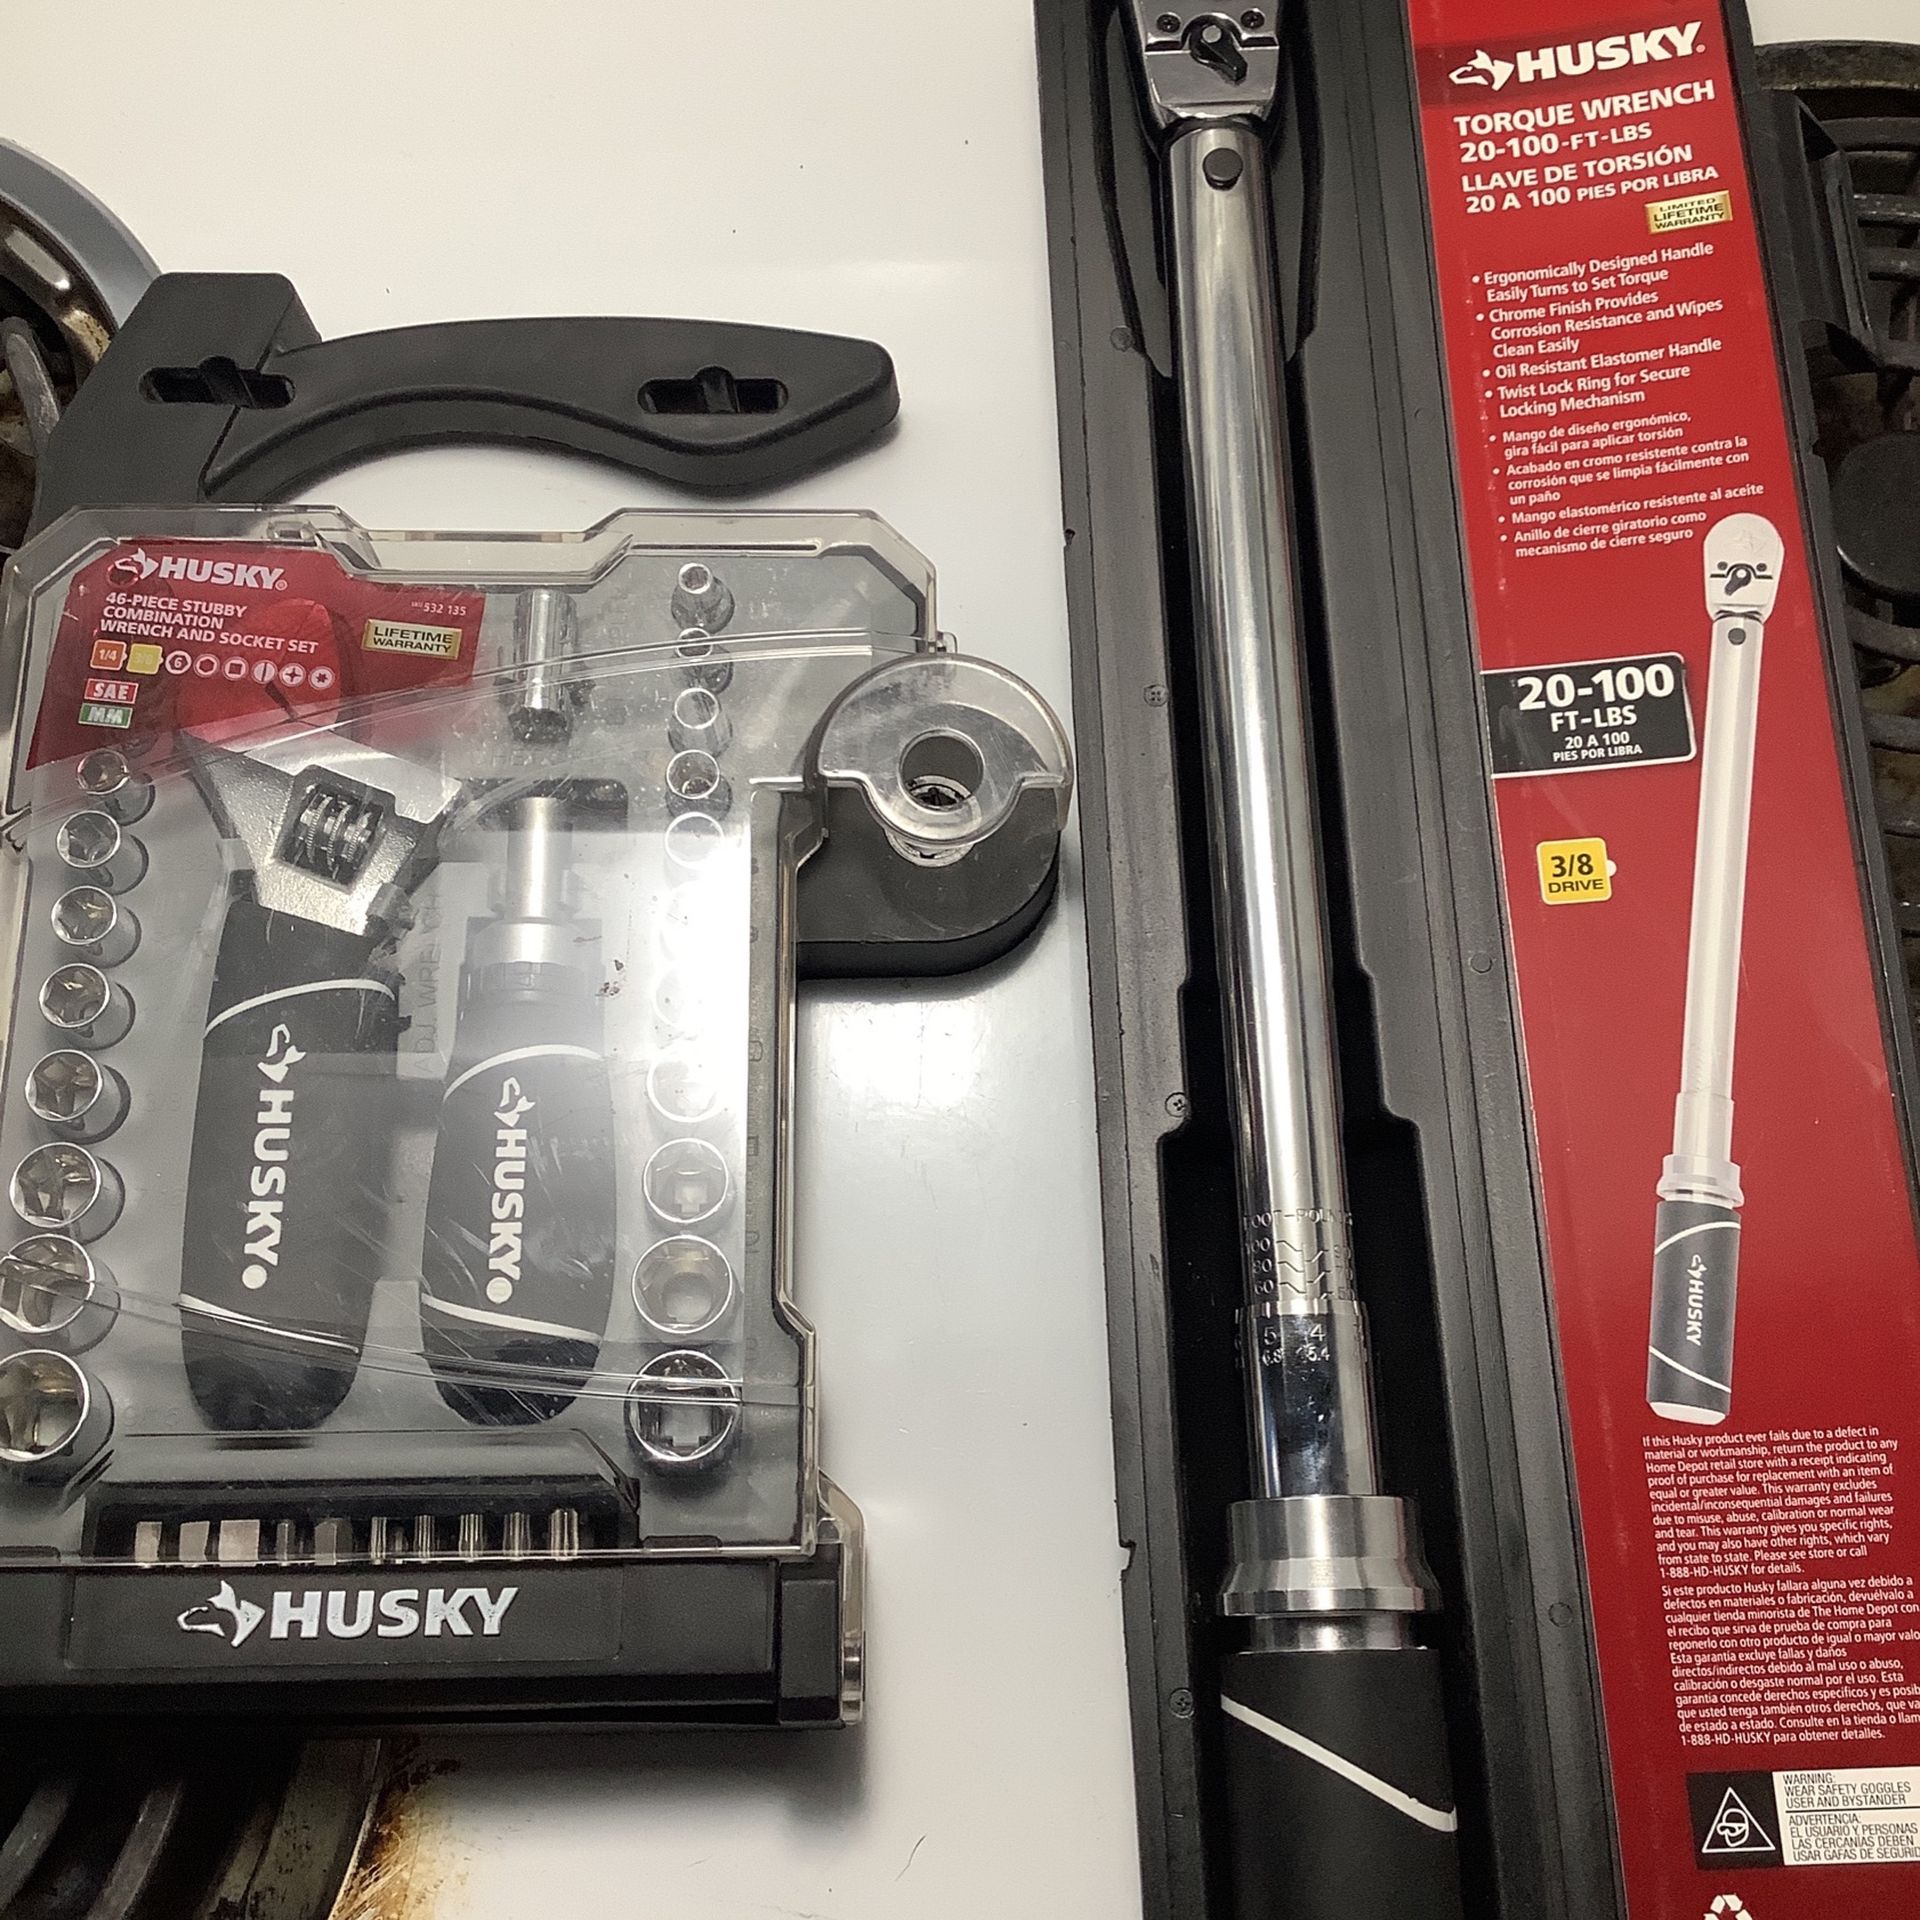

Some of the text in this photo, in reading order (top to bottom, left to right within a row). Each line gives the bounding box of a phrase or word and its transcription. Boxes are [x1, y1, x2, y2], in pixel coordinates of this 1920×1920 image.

[1454, 79, 1715, 137] TORQUE WRENCH
[1462, 144, 1693, 192] LLAVE DE TORSIÓN
[1466, 164, 1717, 213] 20 A 100 PIES POR LIBRA
[1653, 203, 1724, 221] LIFETIME
[1659, 198, 1716, 212] LIMITED
[1655, 212, 1725, 230] WARRANTY
[1485, 243, 1713, 286] Ergonomically Designed Handle
[1487, 270, 1668, 302] Easily Turns to Set Torque
[1489, 291, 1658, 323] Chrome Finish Provides
[1491, 301, 1722, 340] Corrosion Resistance and Wipes
[1493, 335, 1579, 357] Clean Easily
[1495, 338, 1721, 378] Oil Resistant Elastomer Handle
[1500, 367, 1689, 399] Twist Lock Ring for Secure
[1500, 391, 1644, 417] Locking Mechanism
[1503, 412, 1690, 443] Mango de diseño ergonómico,
[1504, 427, 1682, 459] gira fácil para aplicar torsión
[1506, 436, 1746, 476] Acabado en cromo resistente contra la
[1508, 454, 1748, 490] corrosión que se limpia fácilmente con
[1510, 489, 1560, 505] un paño
[1512, 485, 1763, 523] Mango elastomérico resistente al aceite
[1514, 513, 1706, 542] Anillo de cierre giratorio como
[1516, 530, 1692, 557] mecanismo de cierre seguro
[106, 592, 246, 617] 46-PIECE STUBBY
[423, 602, 466, 616] 532 135
[103, 607, 223, 629] COMBINATION
[100, 619, 318, 653] WRENCH AND SOCKET SET
[373, 638, 452, 653] WARRANTY
[374, 627, 453, 643] LIFETIME
[99, 649, 117, 661] 1/4
[174, 657, 182, 668] 6
[94, 683, 129, 700] SAE
[1517, 663, 1674, 711] 20-100
[88, 707, 122, 723] MM
[1551, 705, 1637, 732] FT-LBS
[1565, 731, 1630, 750] 20 A 100
[1553, 744, 1643, 762] PIES POR LIBRA
[1550, 853, 1594, 878] 3/8
[1548, 879, 1604, 893] DRIVE
[244, 1089, 294, 1266] HUSKY
[489, 1129, 527, 1280] HUSKY
[1686, 1280, 1705, 1346] HUSKY
[1263, 1324, 1278, 1346] 5
[1310, 1323, 1326, 1343] 4
[1643, 1425, 1878, 1447] If this Husky product ever fails due to a defect in
[1661, 1561, 1804, 1578] 1-888-HD-HUSKY for details.
[270, 1587, 518, 1639] HUSKY
[1682, 1728, 1884, 1745] 1-888-HD-HUSKY para obtener detalles.
[1783, 1773, 1836, 1784] WARNING:
[1784, 1782, 1910, 1796] WEAR SAFETY GOGGLES
[1786, 1794, 1905, 1808] USER AND BYSTANDER
[1789, 1813, 1861, 1826] ADVERTENCIA:
[1790, 1823, 1917, 1837] EL USUARIO Y PERSONAS
[1792, 1835, 1913, 1849] LAS CERCANÍAS DEBEN
[1793, 1850, 1821, 1861] USAR
[1824, 1849, 1856, 1860] GAFAS
[1860, 1849, 1873, 1859] DE
